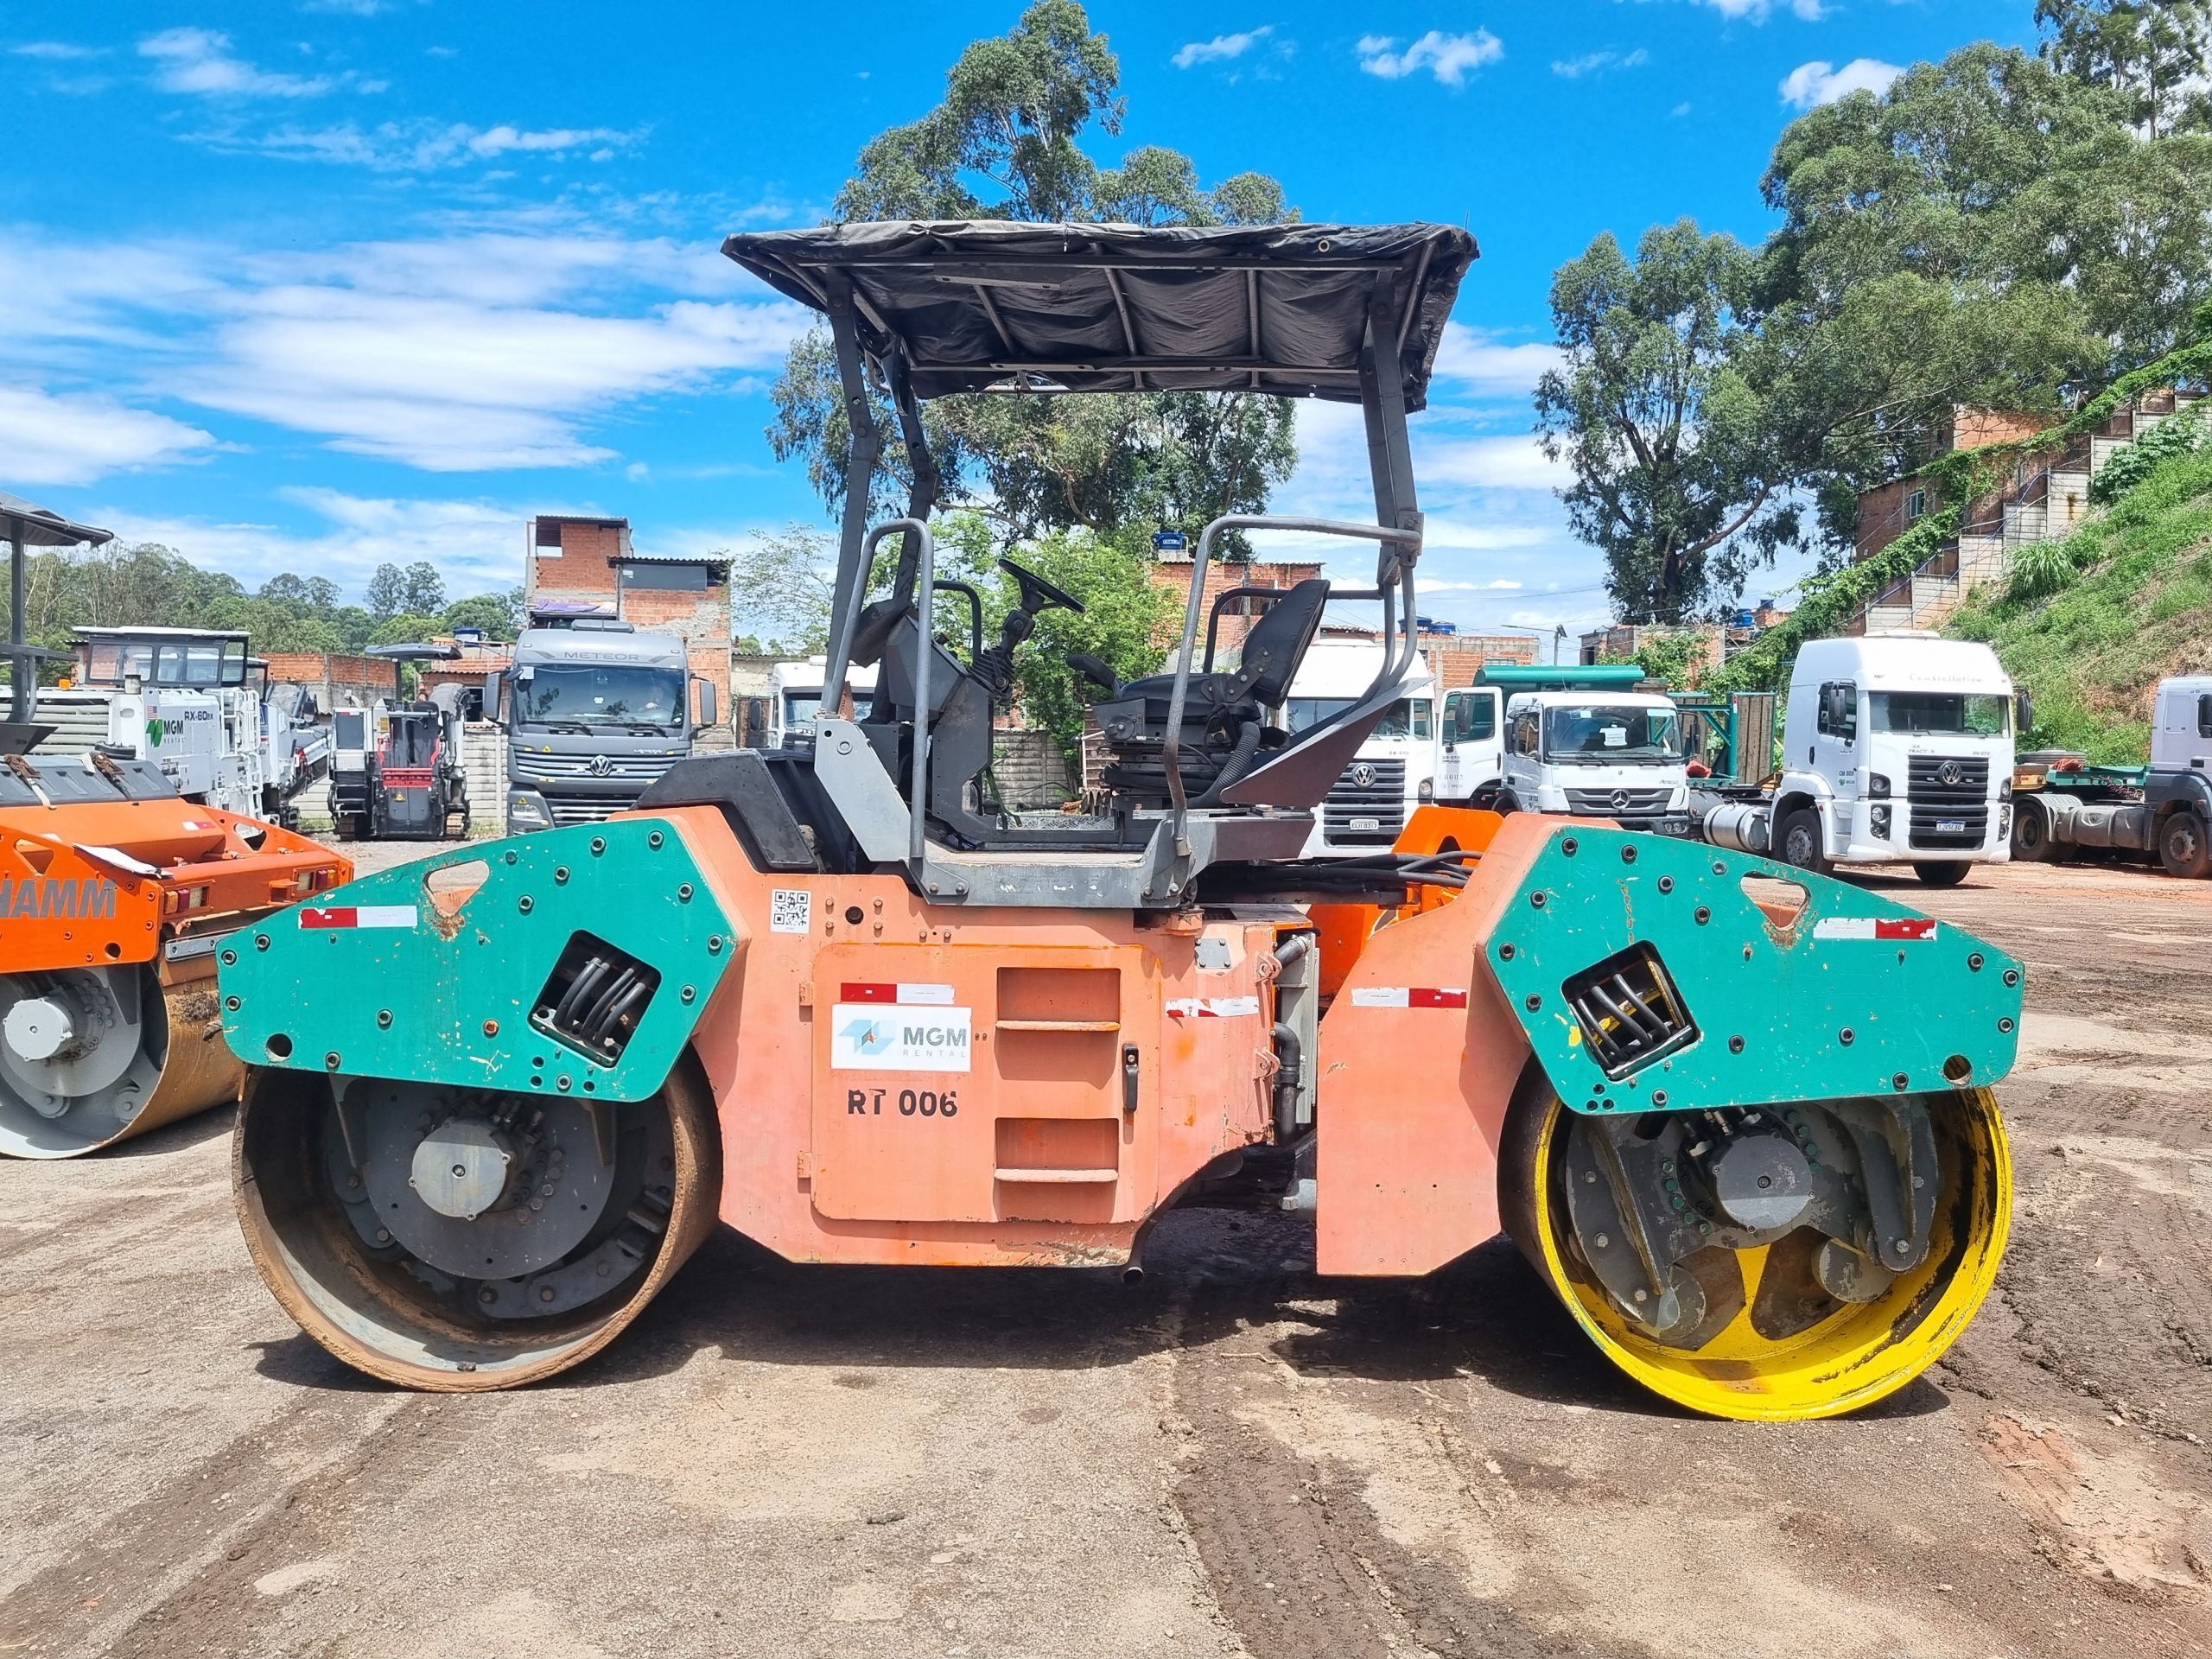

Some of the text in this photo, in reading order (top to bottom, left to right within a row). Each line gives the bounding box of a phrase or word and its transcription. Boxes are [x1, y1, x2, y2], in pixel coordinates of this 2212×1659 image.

[564, 652, 639, 661] METEOR
[164, 720, 184, 735] MGM
[903, 1027, 967, 1046] MGM
[903, 1049, 966, 1058] RENTAL
[848, 1088, 958, 1117] RT 006
